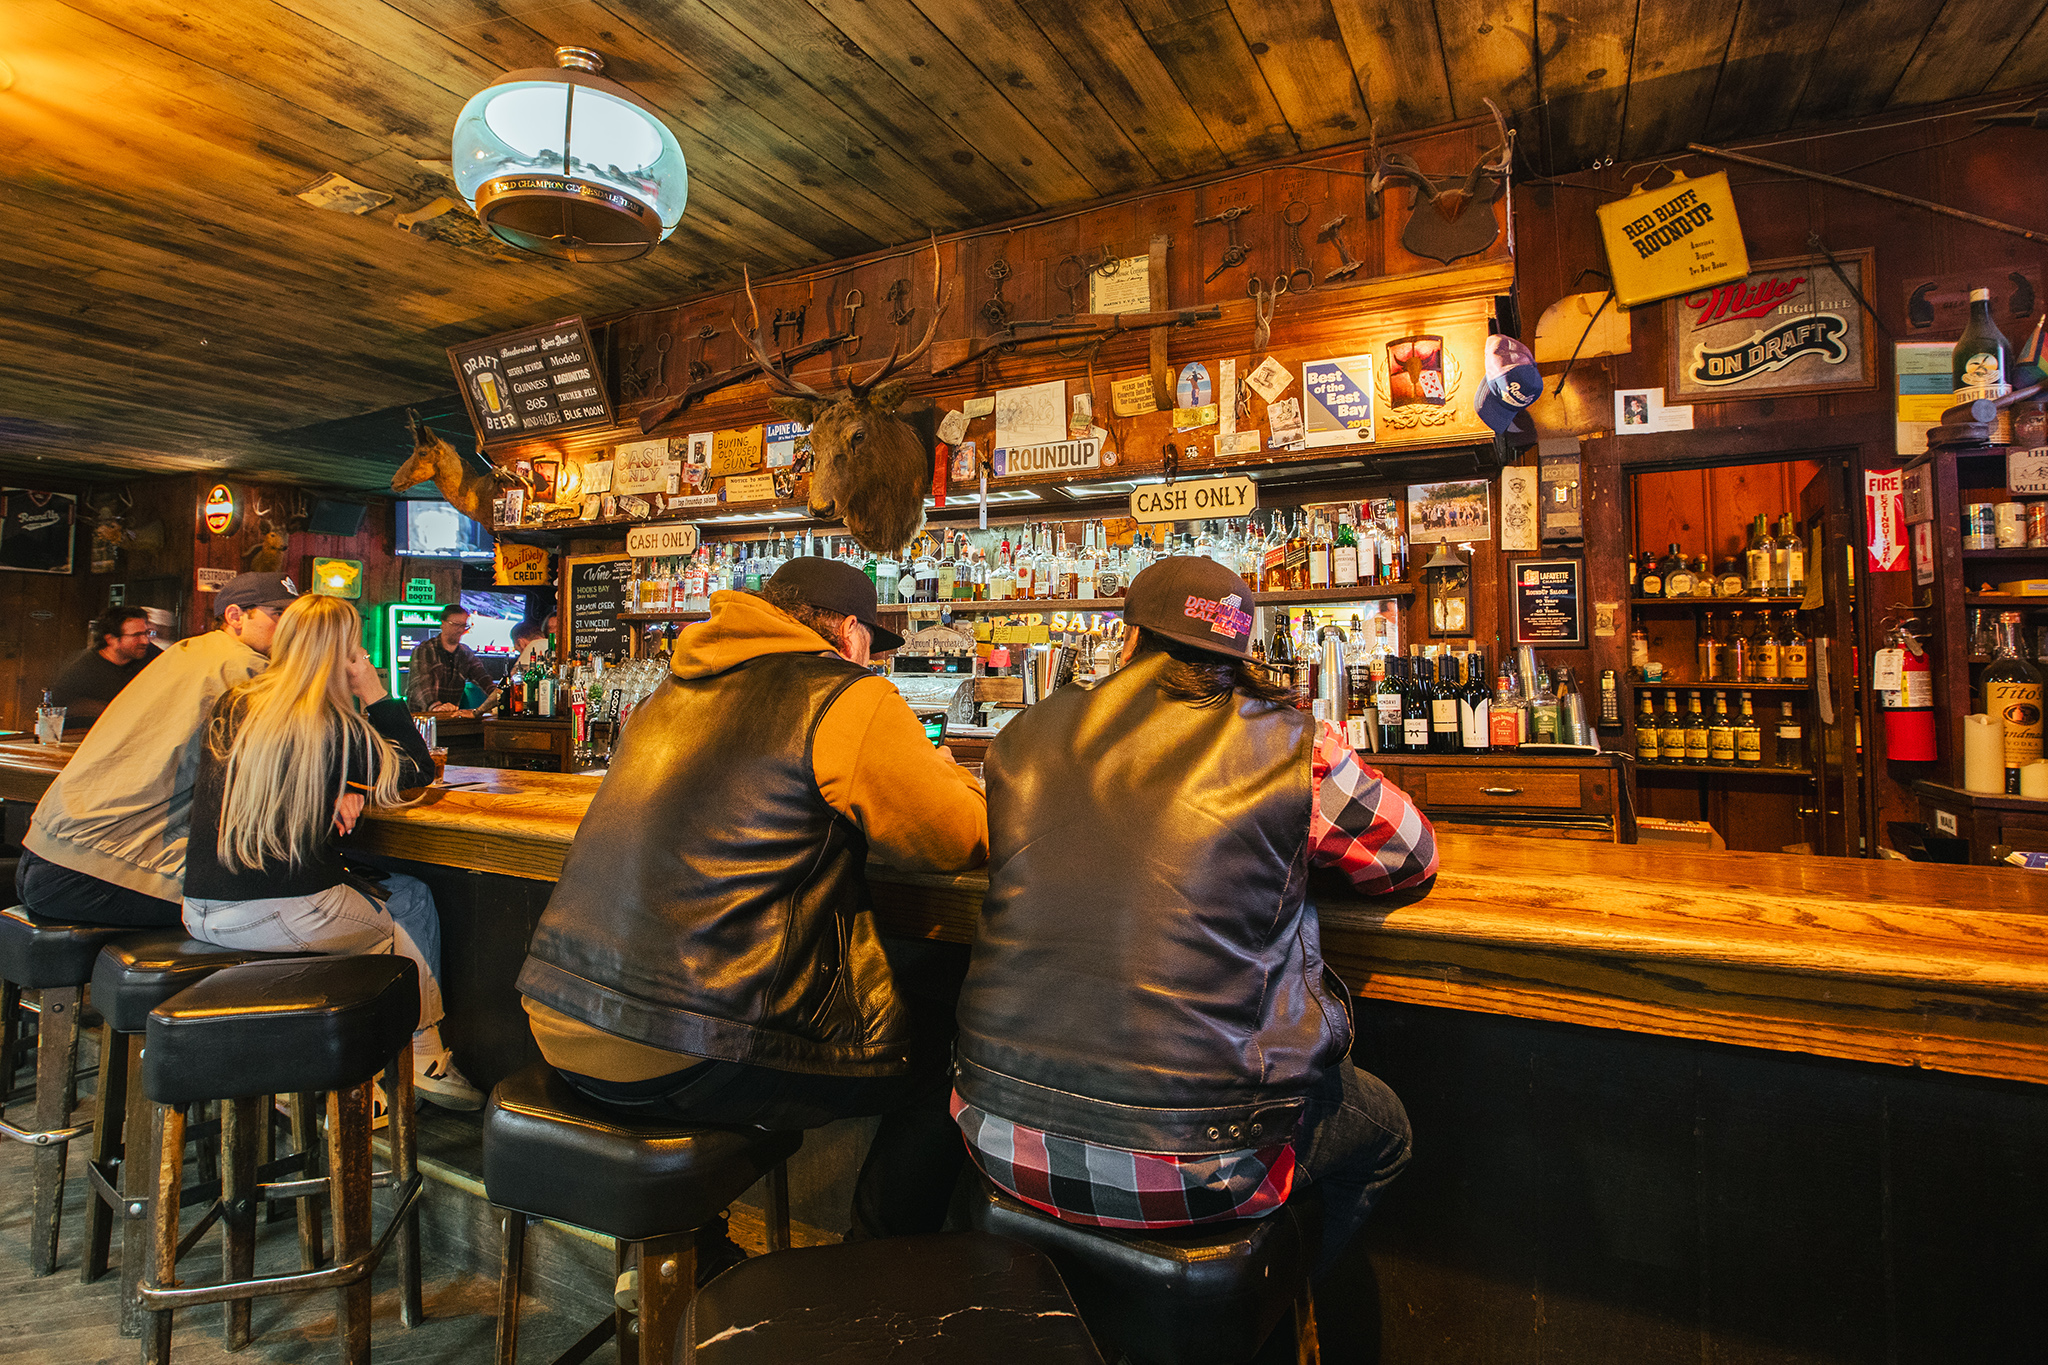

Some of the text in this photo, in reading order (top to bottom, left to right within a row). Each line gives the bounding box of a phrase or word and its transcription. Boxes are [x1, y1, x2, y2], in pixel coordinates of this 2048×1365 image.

[518, 180, 564, 189] CHAMPION
[566, 183, 619, 205] CLYDESDALE
[1622, 188, 1698, 240] RED BLUFF
[1689, 266, 1700, 276] Two
[1685, 276, 1808, 326] Miller
[1778, 300, 1850, 315] HIGH LIFE
[500, 344, 537, 358] Budweiser
[1708, 324, 1826, 376] ON DRAFT
[463, 355, 498, 375] DRAFT
[550, 352, 580, 366] Modelo
[553, 368, 590, 386] LAGUNITAS
[1308, 370, 1342, 385] Best
[514, 379, 548, 394] GUINNESS
[1314, 383, 1345, 394] of the
[526, 397, 548, 410] 805
[1326, 391, 1360, 405] East
[564, 405, 604, 421] BLUE MOON
[1338, 404, 1368, 418] Bay
[486, 413, 516, 430] BEER
[1347, 418, 1371, 429] 2015
[718, 436, 749, 449] BUYING
[617, 446, 666, 471] CASH
[718, 446, 758, 459] OLD/USED
[1008, 442, 1095, 472] ROUNDUP
[723, 456, 754, 470] GUNS
[620, 468, 660, 484] ONLY
[1869, 477, 1898, 492] FIRE
[1137, 485, 1248, 512] CASH ONLY
[1881, 494, 1891, 563] EXTINGUISHER
[630, 531, 693, 550] CASH ONLY
[502, 548, 544, 571] Positively
[200, 569, 236, 580] RESTROOMS
[513, 572, 543, 582] CREDIT
[583, 564, 612, 581] Wine
[576, 602, 615, 611] SALMON CREEK
[584, 619, 610, 628] VINCENT
[575, 636, 598, 645] BRADY
[908, 638, 930, 649] Amount
[1996, 684, 2043, 701] Tito's
[610, 690, 620, 715] 805
